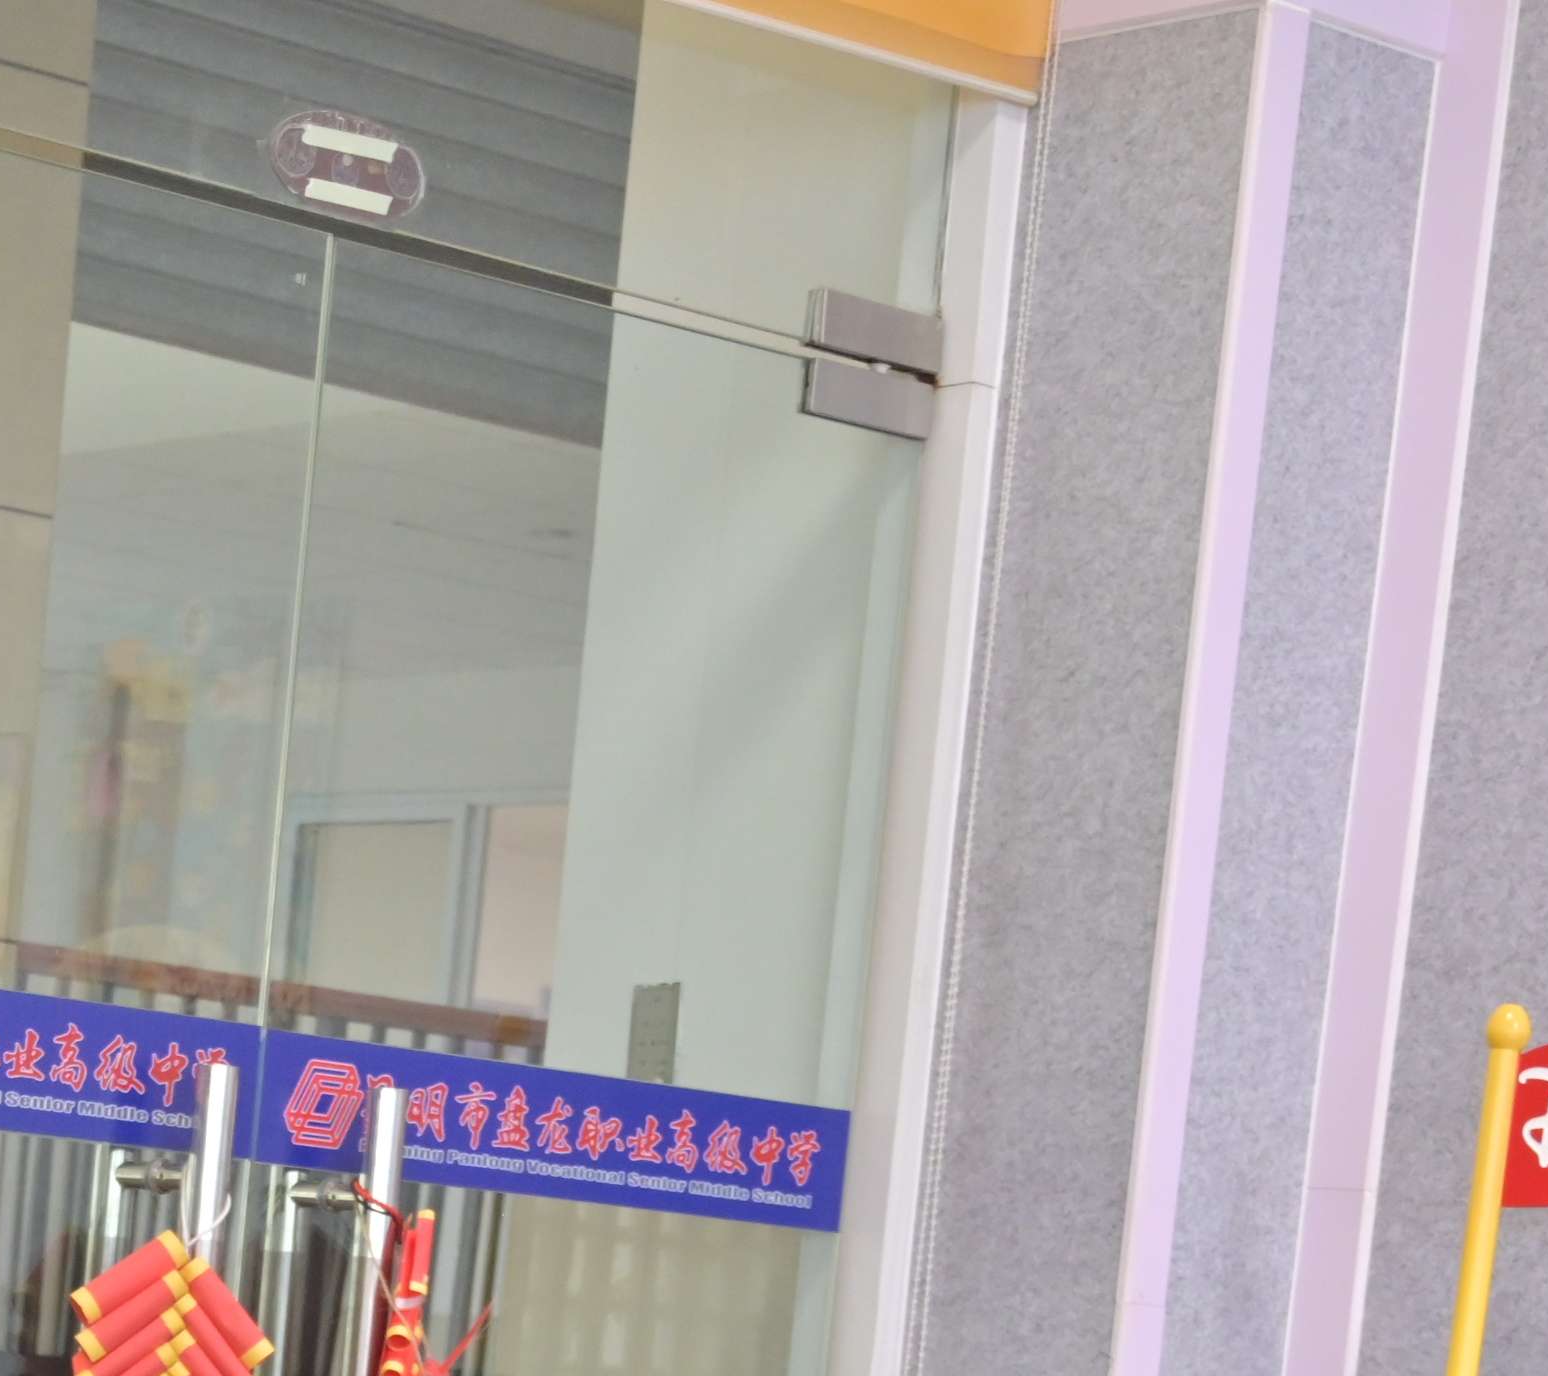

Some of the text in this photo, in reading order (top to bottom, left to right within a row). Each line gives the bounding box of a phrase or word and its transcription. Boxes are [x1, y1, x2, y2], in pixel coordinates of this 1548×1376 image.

[4, 1090, 75, 1114] Senior
[77, 1100, 149, 1123] Middle
[360, 1073, 822, 1187] 明市盘龙职业高级中学
[447, 1148, 524, 1174] Panlong
[526, 1160, 626, 1187] Vocational
[627, 1172, 686, 1193] Senior
[688, 1181, 750, 1202] Middle
[752, 1188, 814, 1210] School
